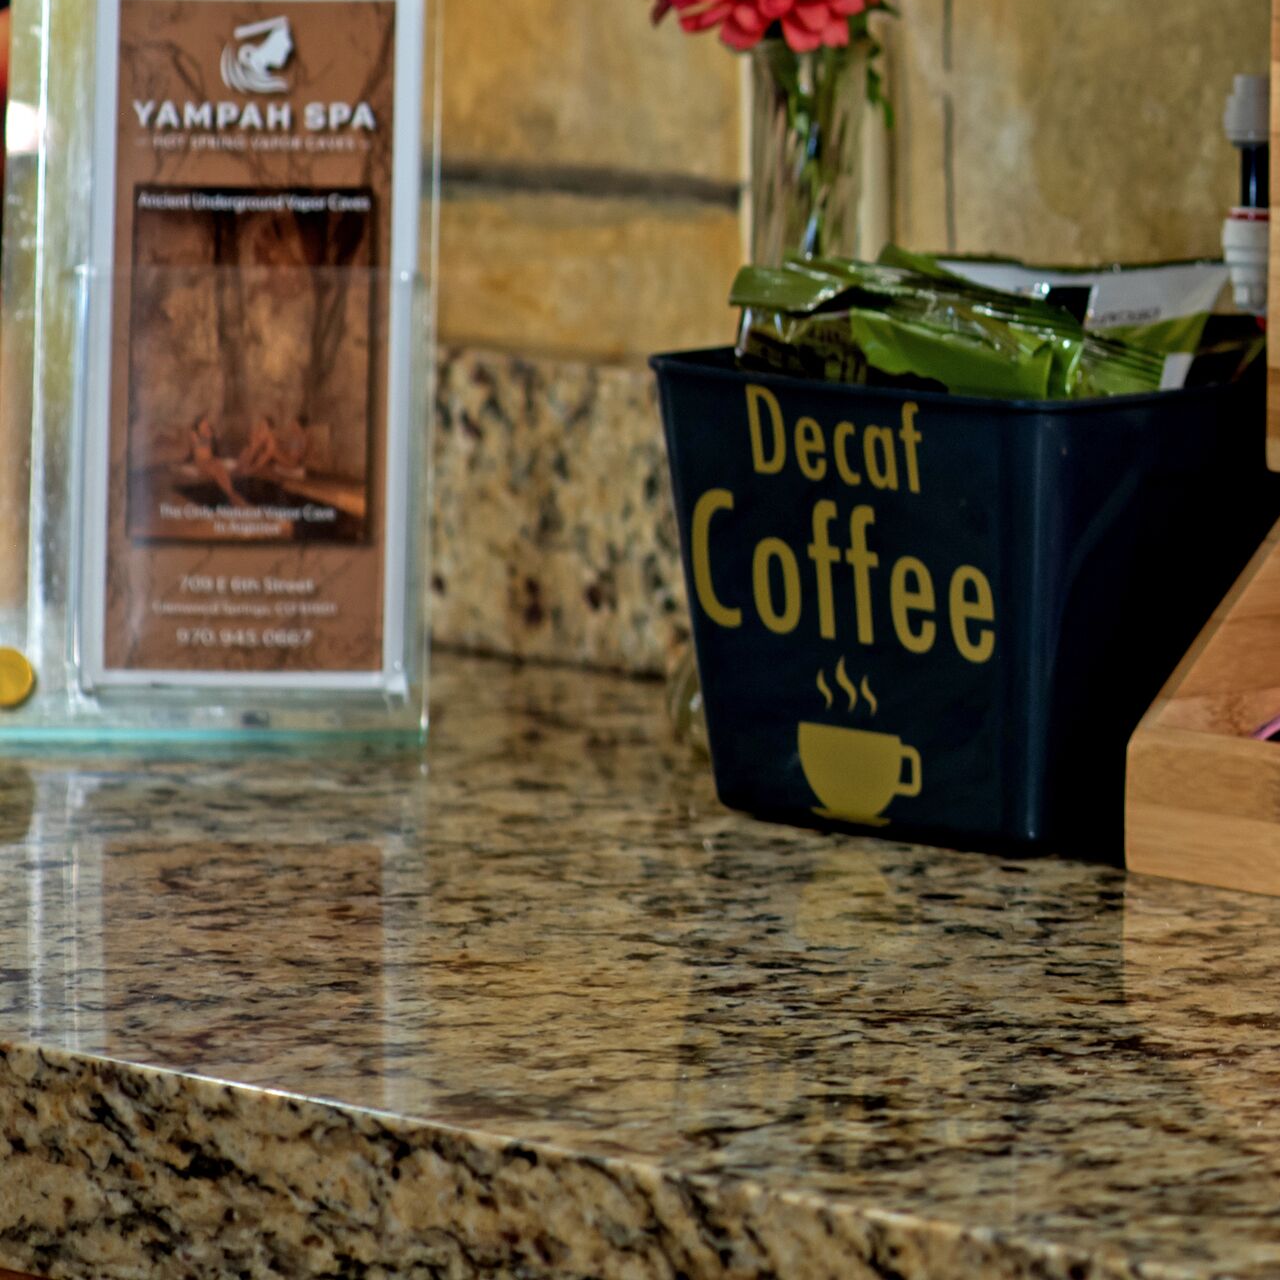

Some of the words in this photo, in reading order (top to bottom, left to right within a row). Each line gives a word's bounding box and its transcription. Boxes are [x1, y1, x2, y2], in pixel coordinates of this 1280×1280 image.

[133, 100, 291, 129] YAMPAH
[304, 101, 376, 130] SPA
[138, 191, 189, 209] Ancient
[191, 193, 283, 214] Underground
[284, 194, 324, 214] Vapor
[745, 384, 923, 494] Decaf
[263, 576, 315, 595] Street
[692, 488, 995, 664] Coffee
